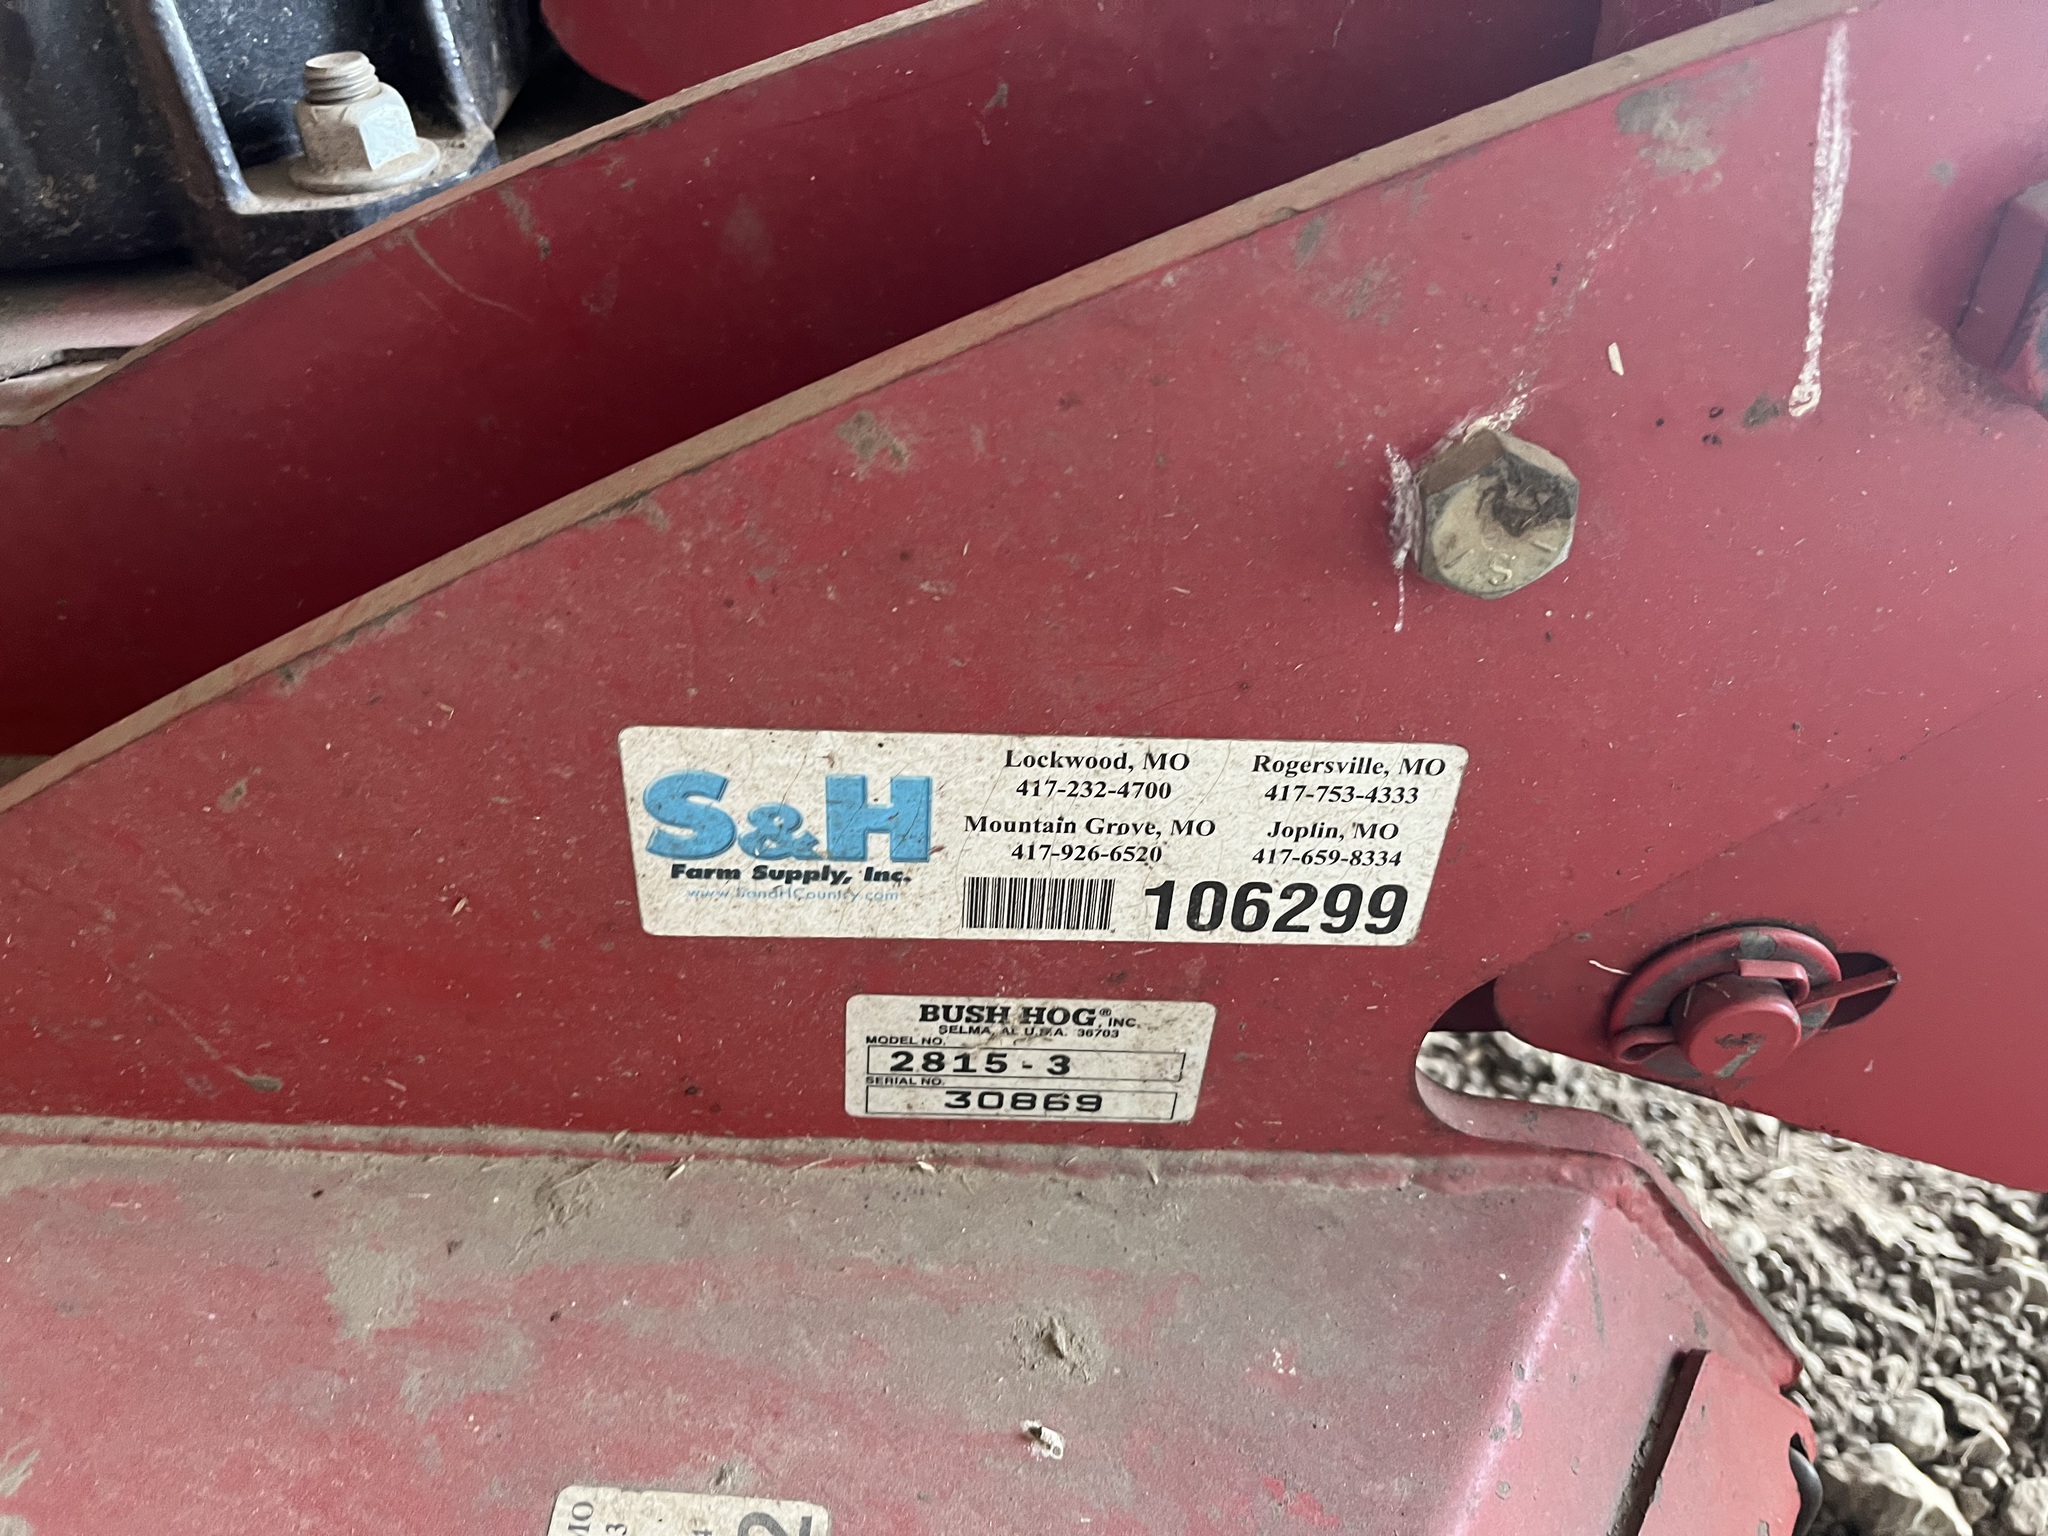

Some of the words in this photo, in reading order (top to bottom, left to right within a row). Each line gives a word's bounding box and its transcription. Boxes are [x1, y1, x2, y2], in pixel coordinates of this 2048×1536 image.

[1004, 750, 1134, 774] Lockwood,
[1142, 752, 1190, 771] MO
[1252, 755, 1390, 778] Rogersville,
[1398, 757, 1446, 776] MO
[1016, 779, 1172, 799] 417-232-4700
[1264, 784, 1419, 804] 417-753-4333
[642, 769, 932, 862] S&H
[964, 815, 1077, 834] Mountain
[1085, 817, 1162, 839] Grove,
[1170, 819, 1216, 837] MO
[1267, 821, 1345, 843] Joplin,
[1353, 822, 1399, 840] MO
[1011, 844, 1163, 863] 417-926-6520
[1251, 848, 1403, 867] 417-659-8334
[670, 863, 742, 880] Farm
[751, 864, 853, 885] Supply,
[863, 866, 913, 882] Inc.
[1144, 880, 1409, 935] 106299
[919, 1004, 1011, 1024] BUSH
[865, 1035, 920, 1045] MODEL
[921, 1037, 946, 1046] NO.
[1077, 1028, 1120, 1038] 36703
[865, 1076, 919, 1085] SERIAL
[920, 1077, 946, 1086] NO.
[944, 1090, 1103, 1112] 30869
